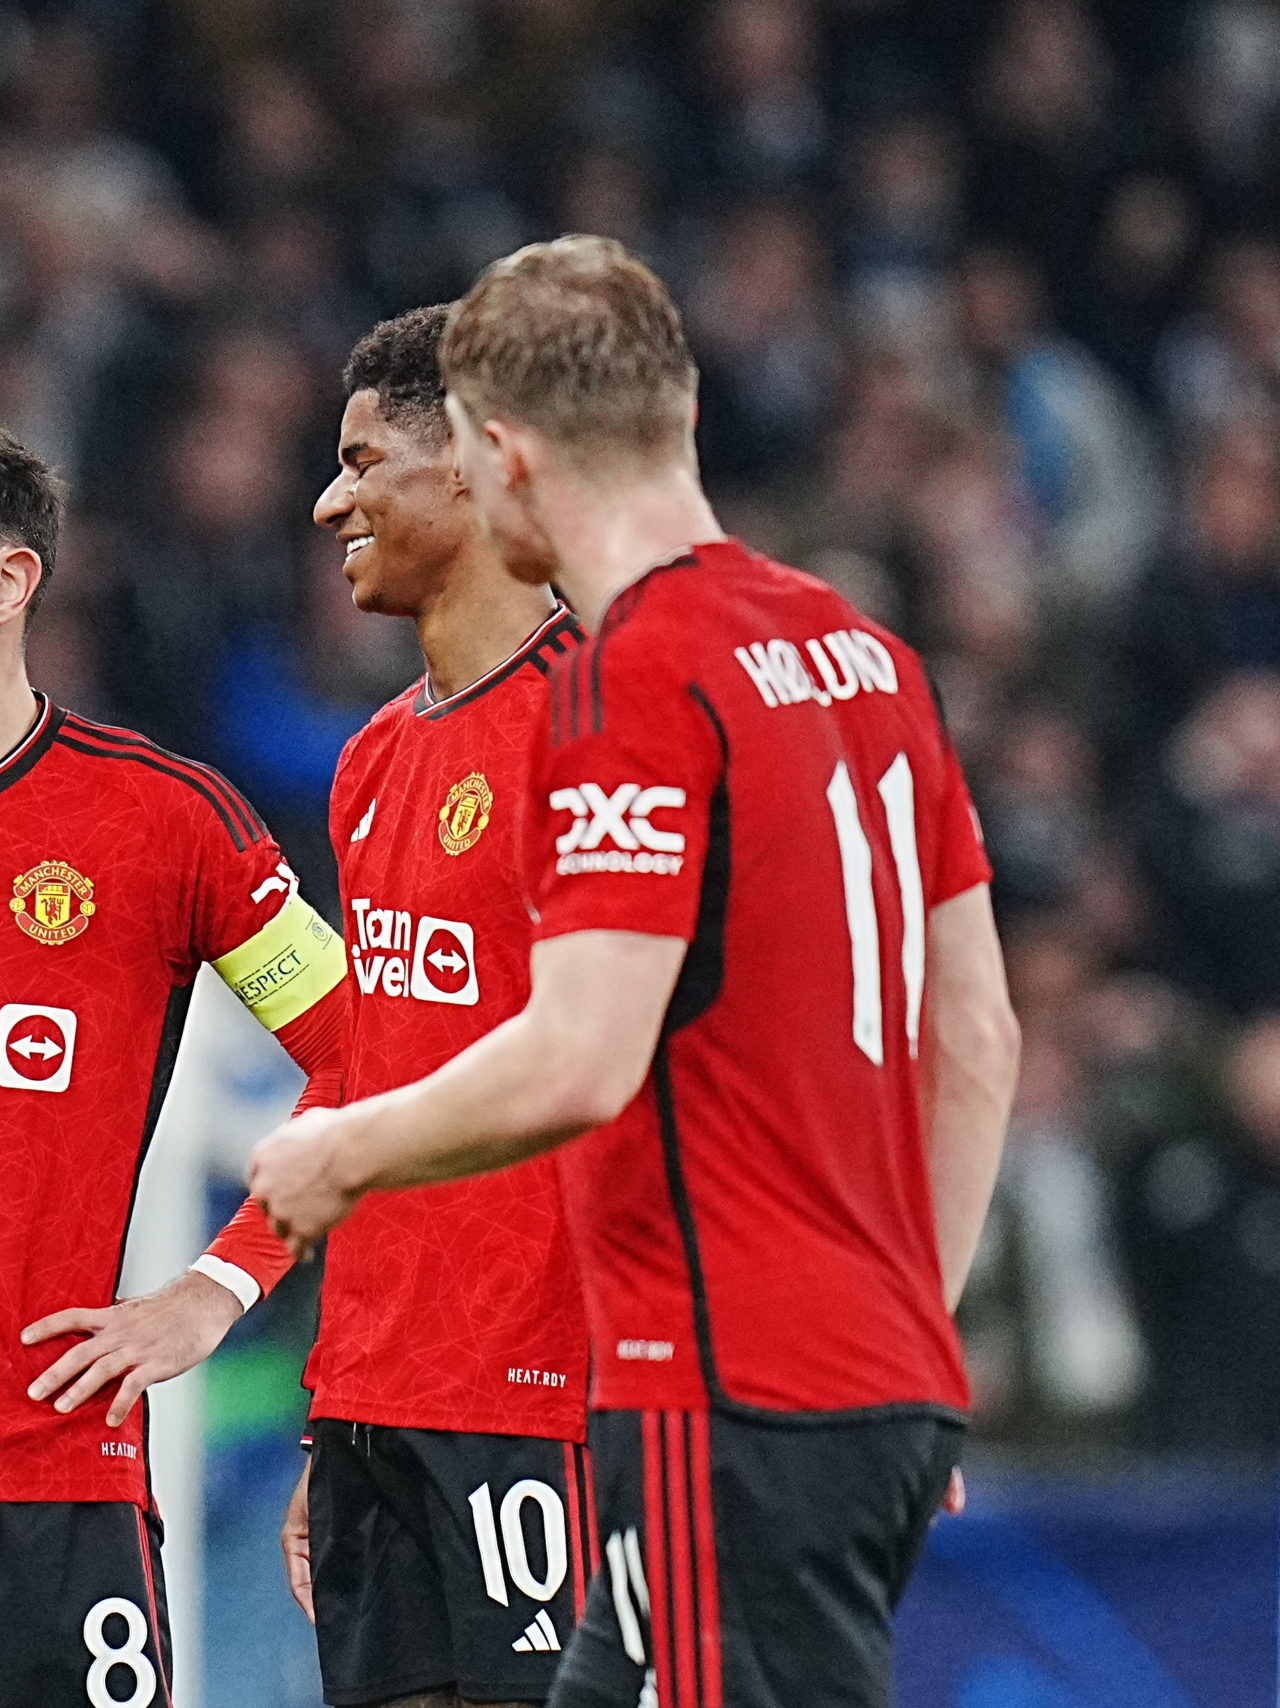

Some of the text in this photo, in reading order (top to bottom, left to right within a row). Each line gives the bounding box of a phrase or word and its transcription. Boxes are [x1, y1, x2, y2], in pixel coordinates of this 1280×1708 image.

[451, 778, 490, 810] MANCHESTER
[549, 782, 686, 854] DXC
[443, 833, 471, 850] UNITED
[19, 866, 88, 895] MANCHESTER
[826, 750, 926, 1067] 11
[28, 924, 77, 939] UNITED
[507, 1367, 567, 1389] HEAT.RDY
[468, 1479, 568, 1607] 10
[83, 1597, 157, 1708] 8
